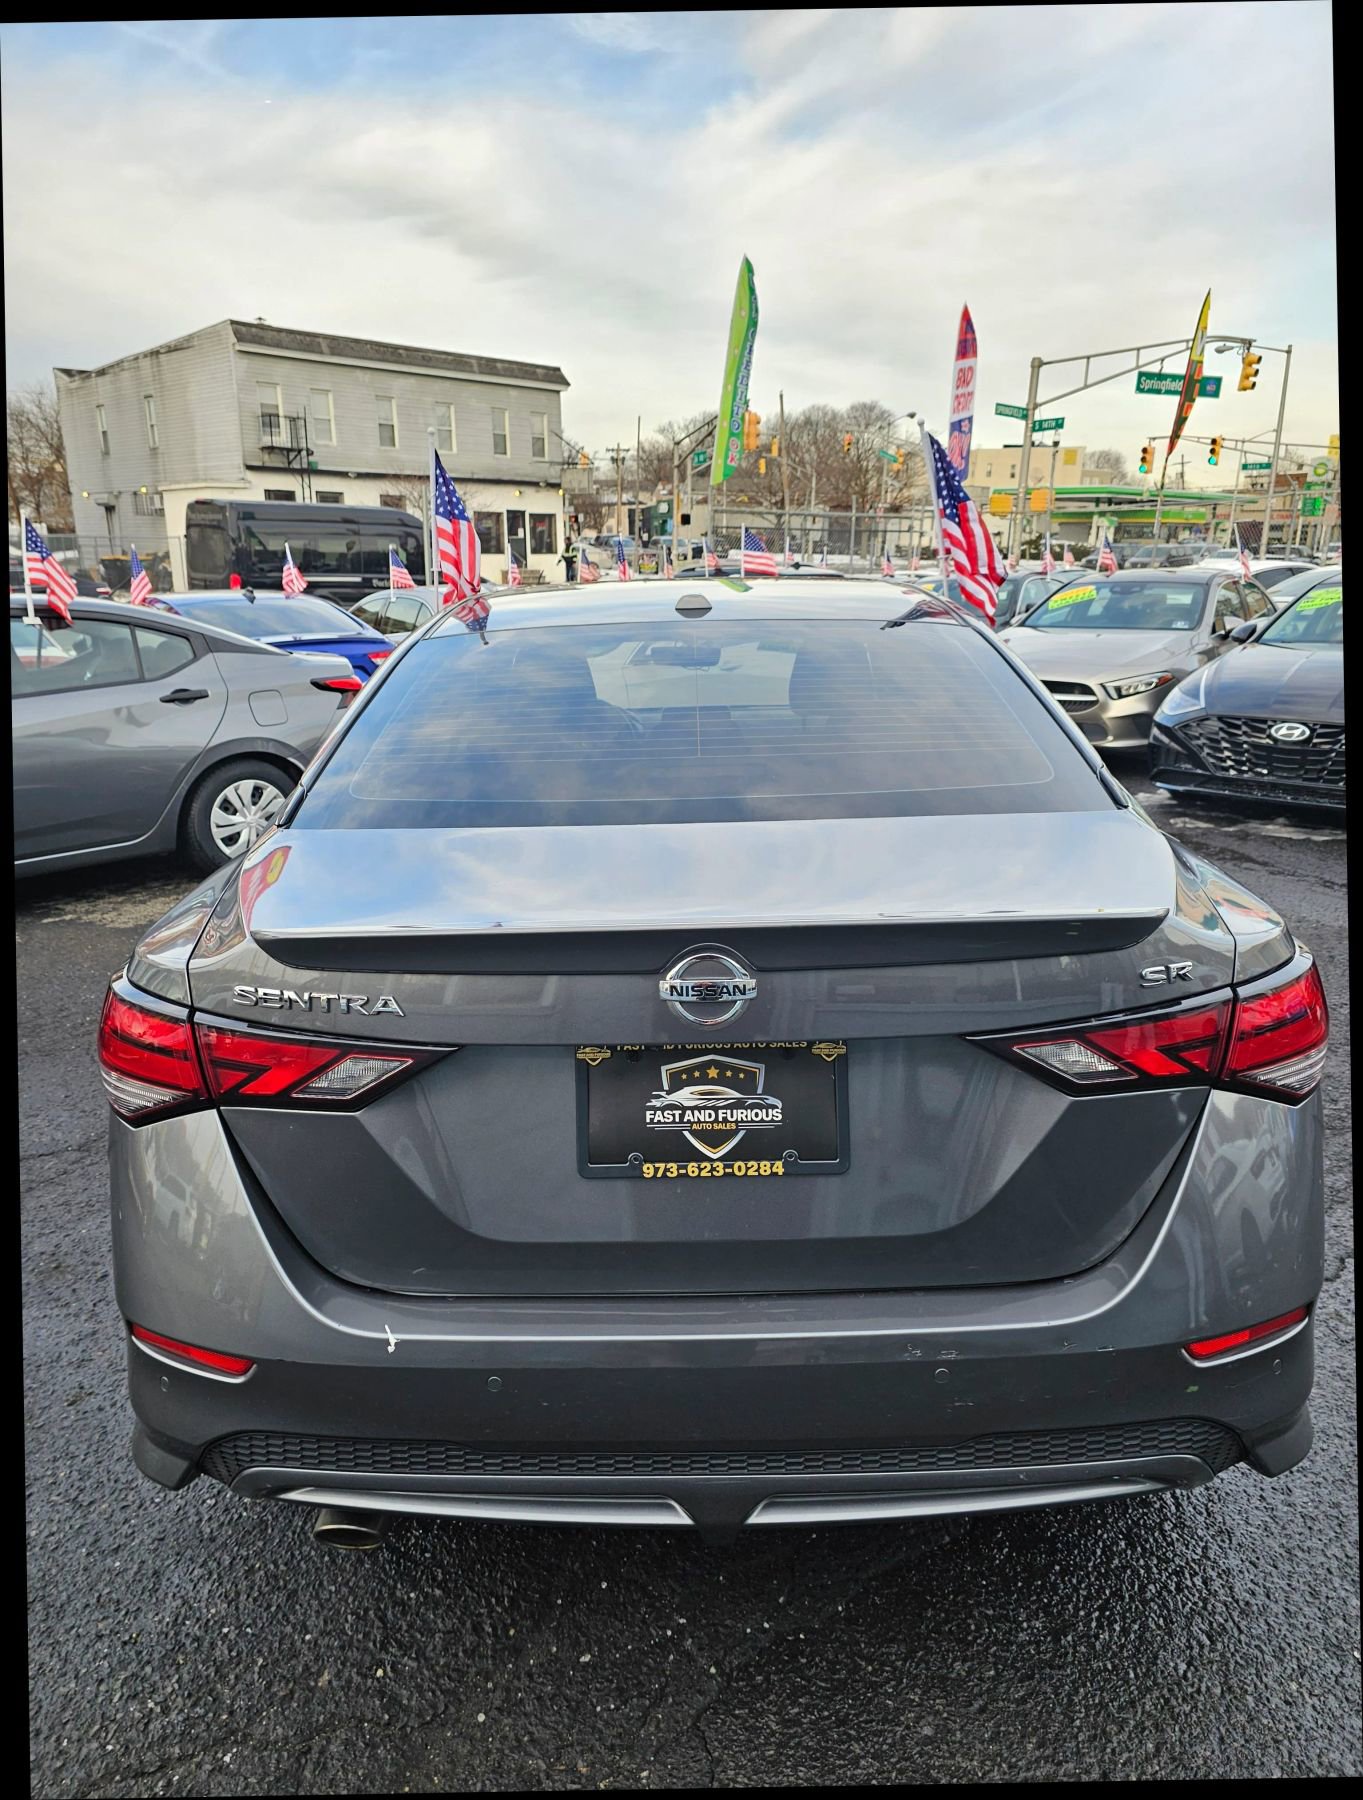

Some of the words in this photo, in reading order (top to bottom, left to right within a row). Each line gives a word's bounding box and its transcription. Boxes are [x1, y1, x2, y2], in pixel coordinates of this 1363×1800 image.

[955, 364, 975, 390] BAD
[1140, 376, 1184, 394] Springfield
[996, 405, 1023, 418] SPRINGFIELD
[1034, 421, 1040, 430] S
[1140, 961, 1194, 988] SR
[669, 984, 747, 998] NISSAN
[233, 985, 406, 1017] SENTRA
[646, 1110, 682, 1122] FAST
[683, 1109, 715, 1122] AND
[718, 1109, 783, 1121] FURIOUS
[713, 1122, 737, 1130] SALES
[642, 1161, 785, 1178] 973-623-0284
